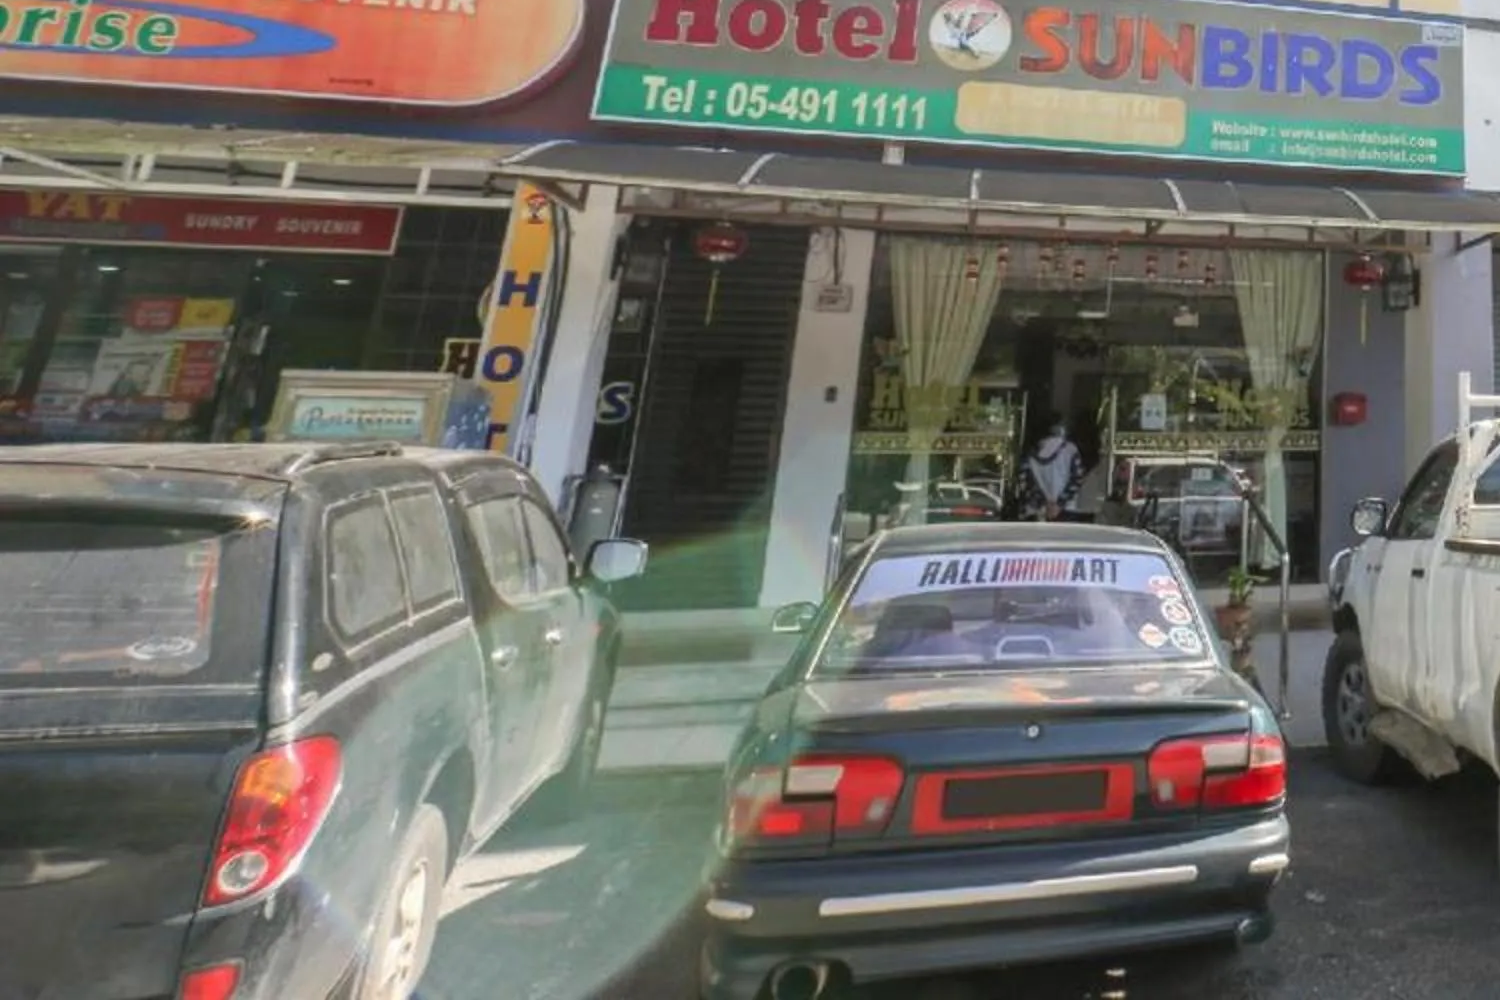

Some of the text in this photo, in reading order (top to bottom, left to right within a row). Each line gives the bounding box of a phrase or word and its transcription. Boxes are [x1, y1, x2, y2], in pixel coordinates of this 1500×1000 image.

[724, 81, 837, 124] 05-491
[852, 90, 927, 131] 1111
[25, 188, 131, 220] VAT
[184, 214, 363, 235] SUNDRY SOUVENIR
